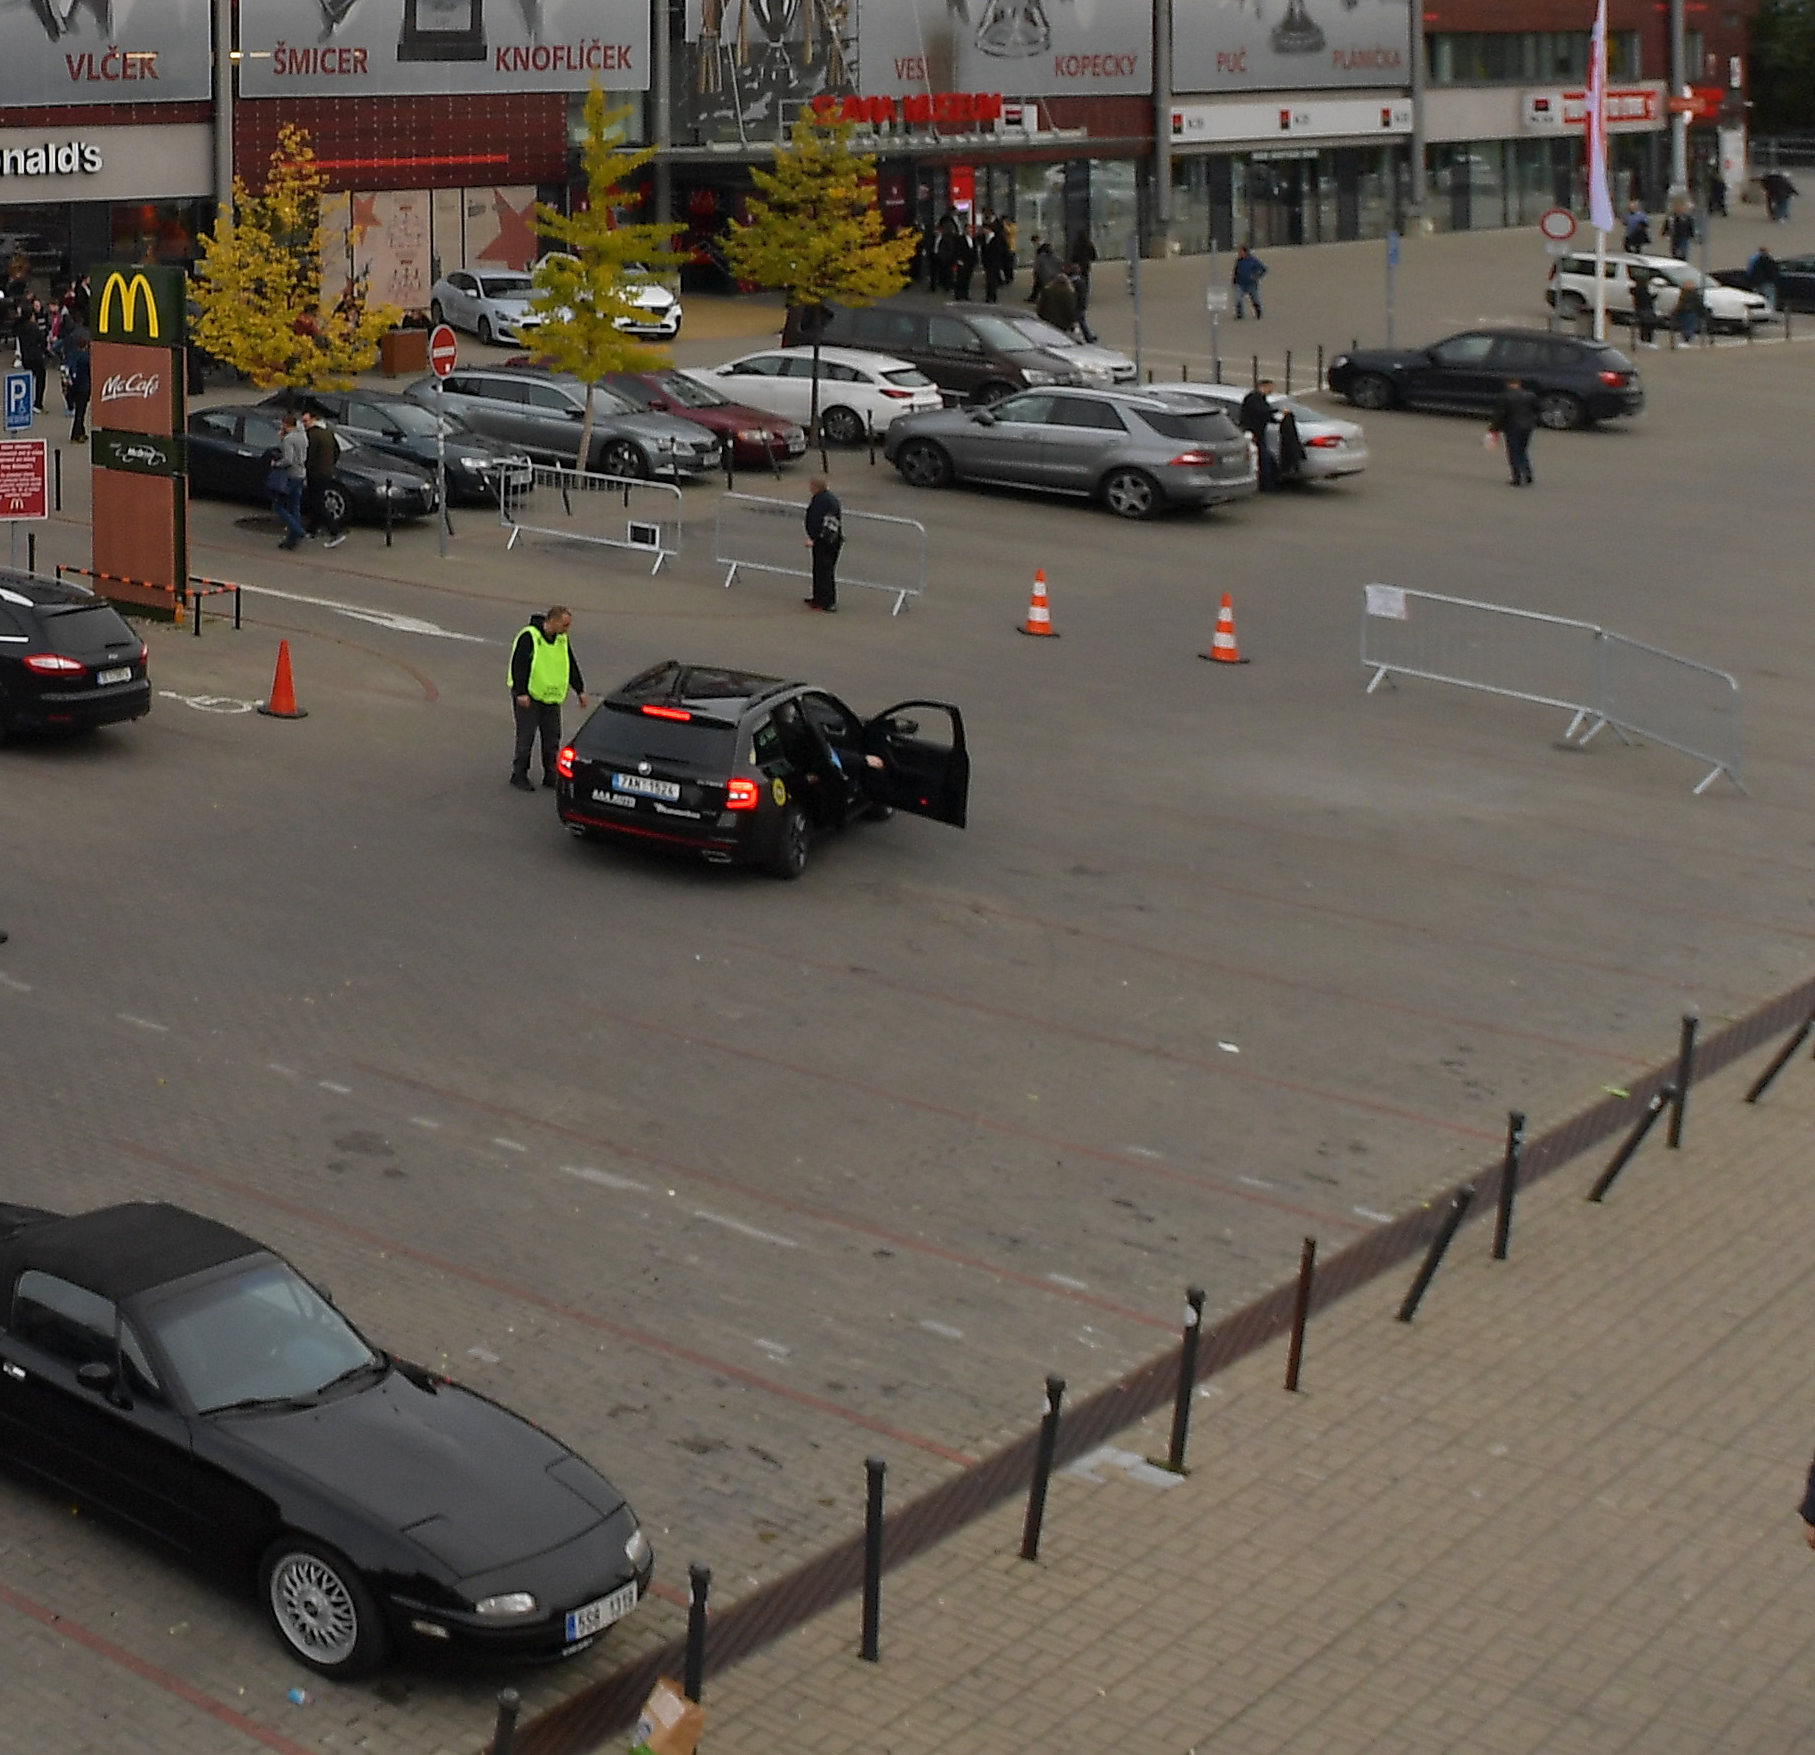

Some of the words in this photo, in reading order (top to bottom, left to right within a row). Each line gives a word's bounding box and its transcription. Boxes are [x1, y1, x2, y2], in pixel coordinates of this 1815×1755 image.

[65, 46, 159, 83] VLČEK
[272, 40, 369, 75] ŠMICER
[494, 38, 633, 72] KNOFLÍČEK
